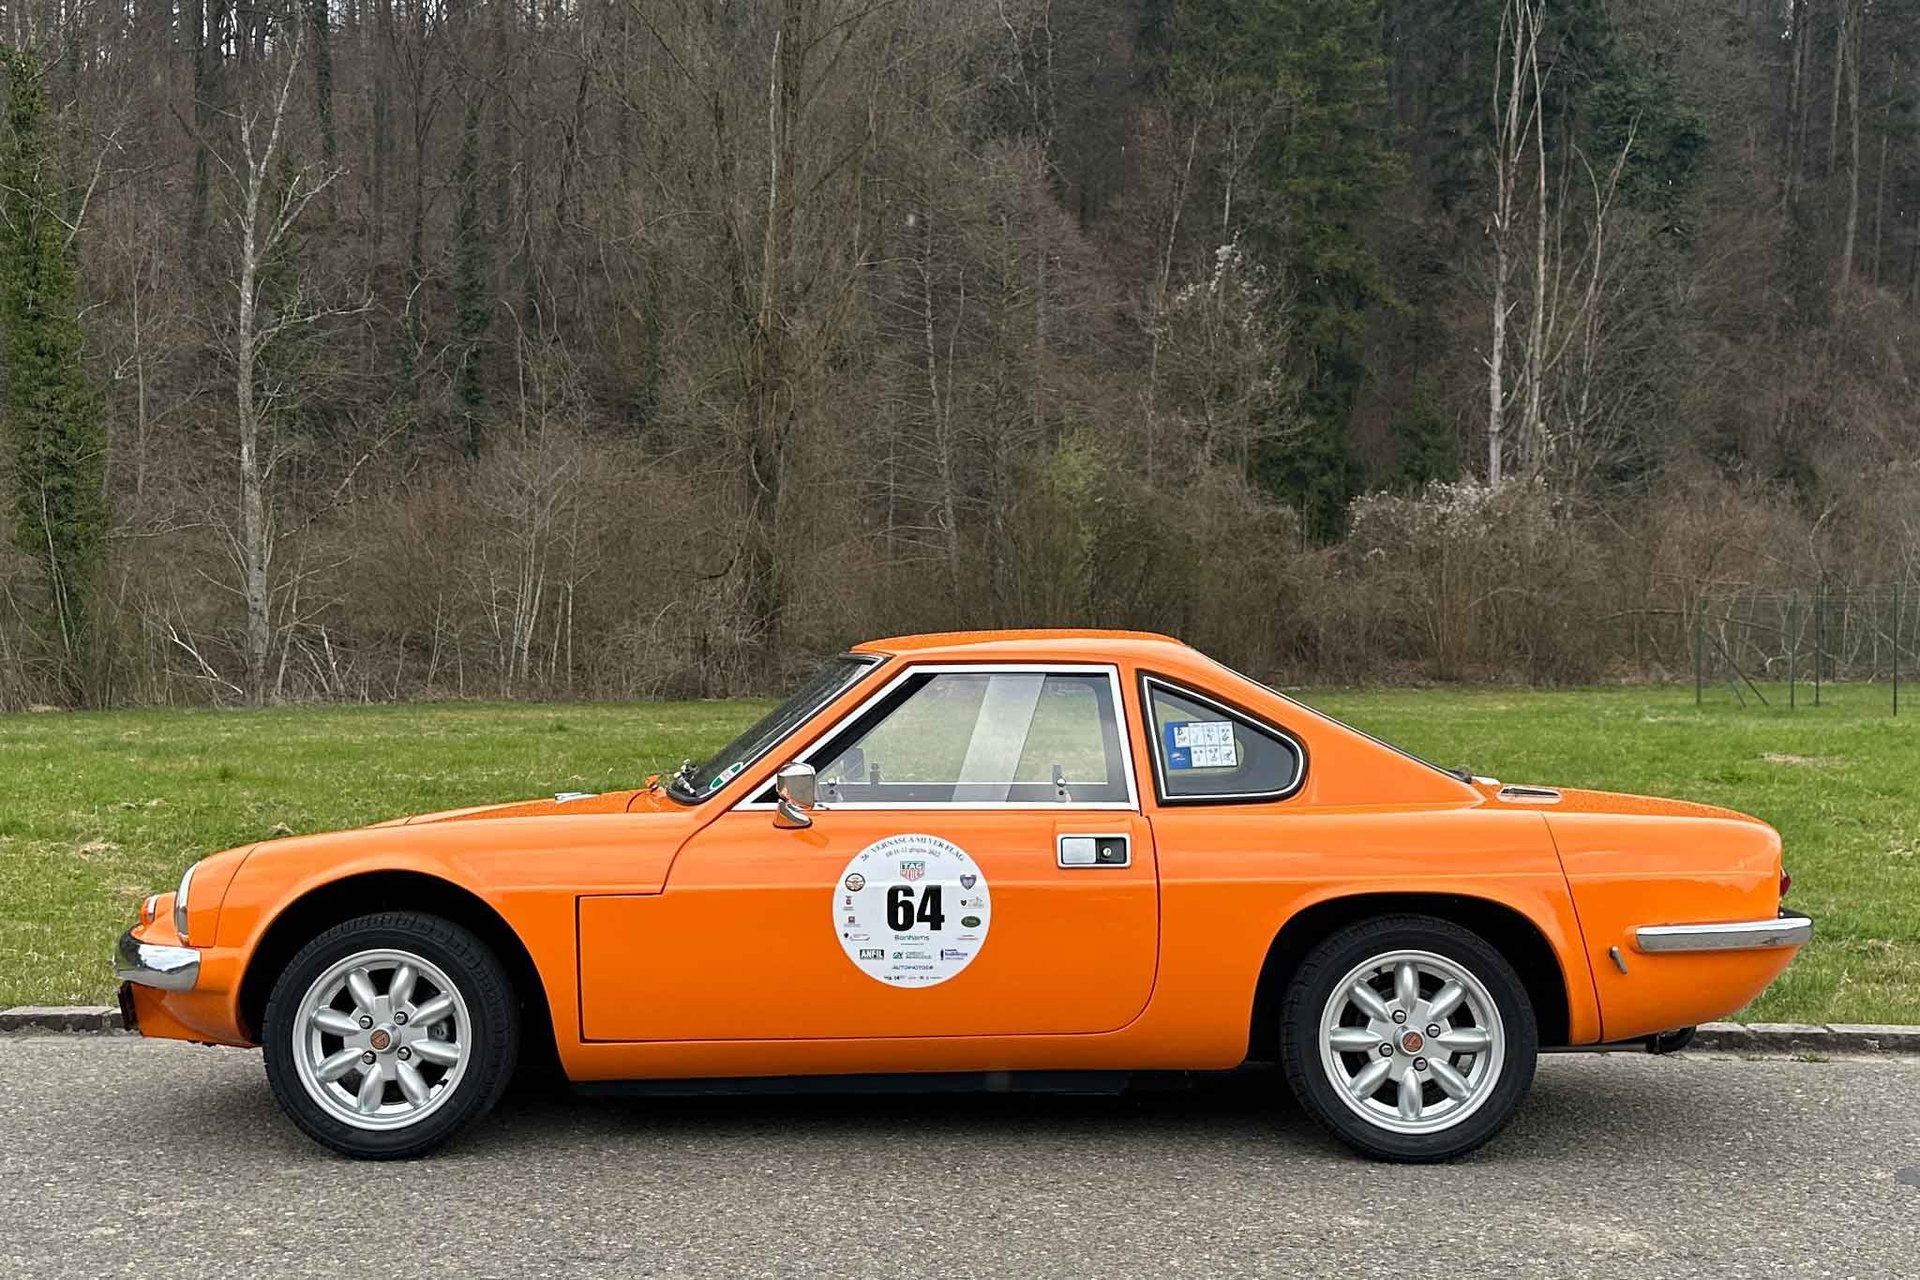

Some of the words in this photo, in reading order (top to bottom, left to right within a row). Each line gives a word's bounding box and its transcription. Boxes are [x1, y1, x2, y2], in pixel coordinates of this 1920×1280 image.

[871, 837, 914, 854] VERNASCA
[915, 836, 945, 849] SILVER
[944, 843, 965, 862] FLAG
[887, 885, 945, 931] 64
[860, 949, 884, 959] ANFIL
